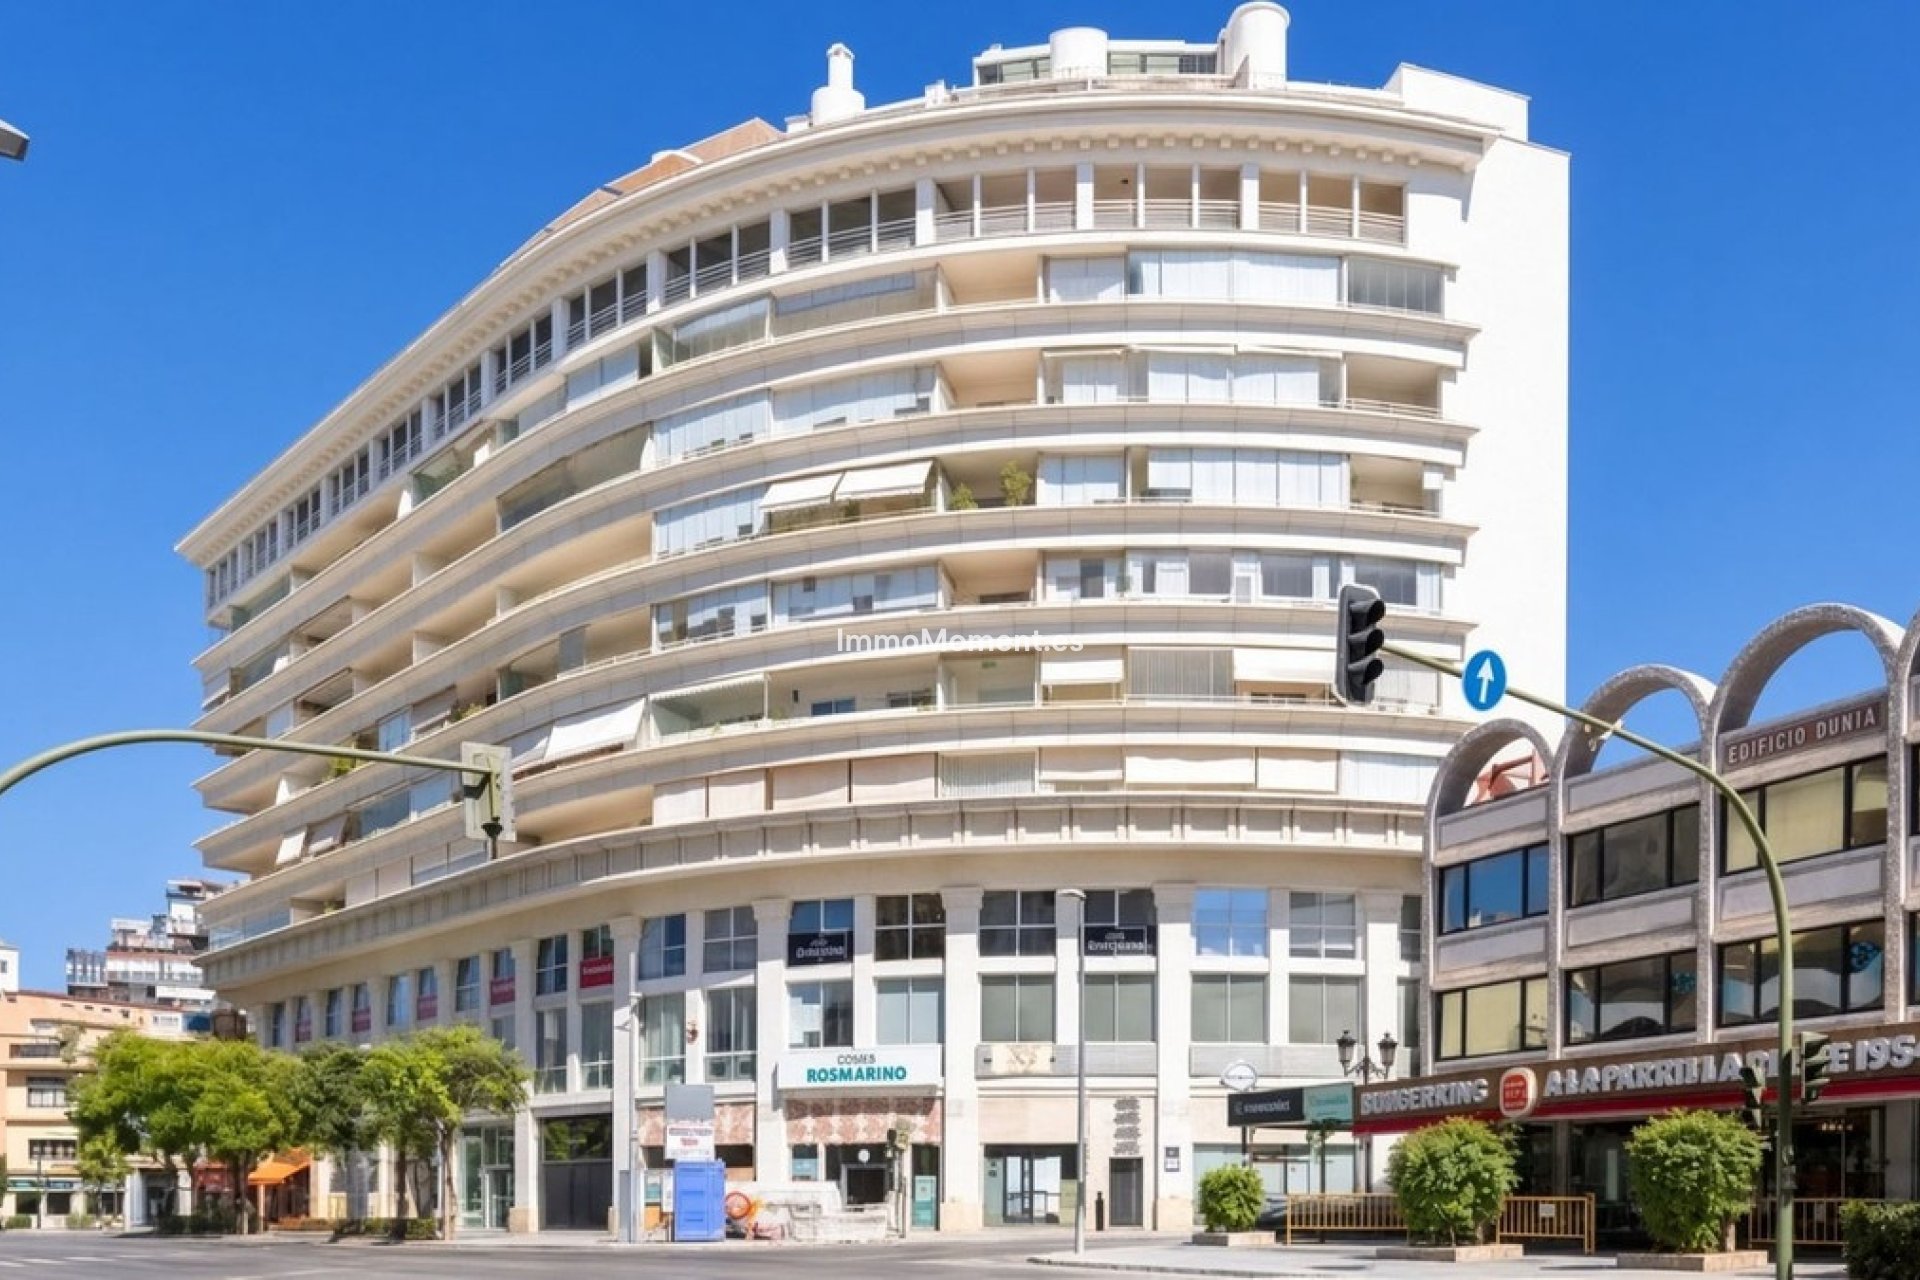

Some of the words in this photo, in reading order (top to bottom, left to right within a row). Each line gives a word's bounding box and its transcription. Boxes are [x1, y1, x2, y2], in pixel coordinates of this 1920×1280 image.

[1728, 727, 1806, 763] EDIFICIO
[1815, 706, 1876, 739] DUNIA
[806, 1065, 907, 1083] ROSMARINO
